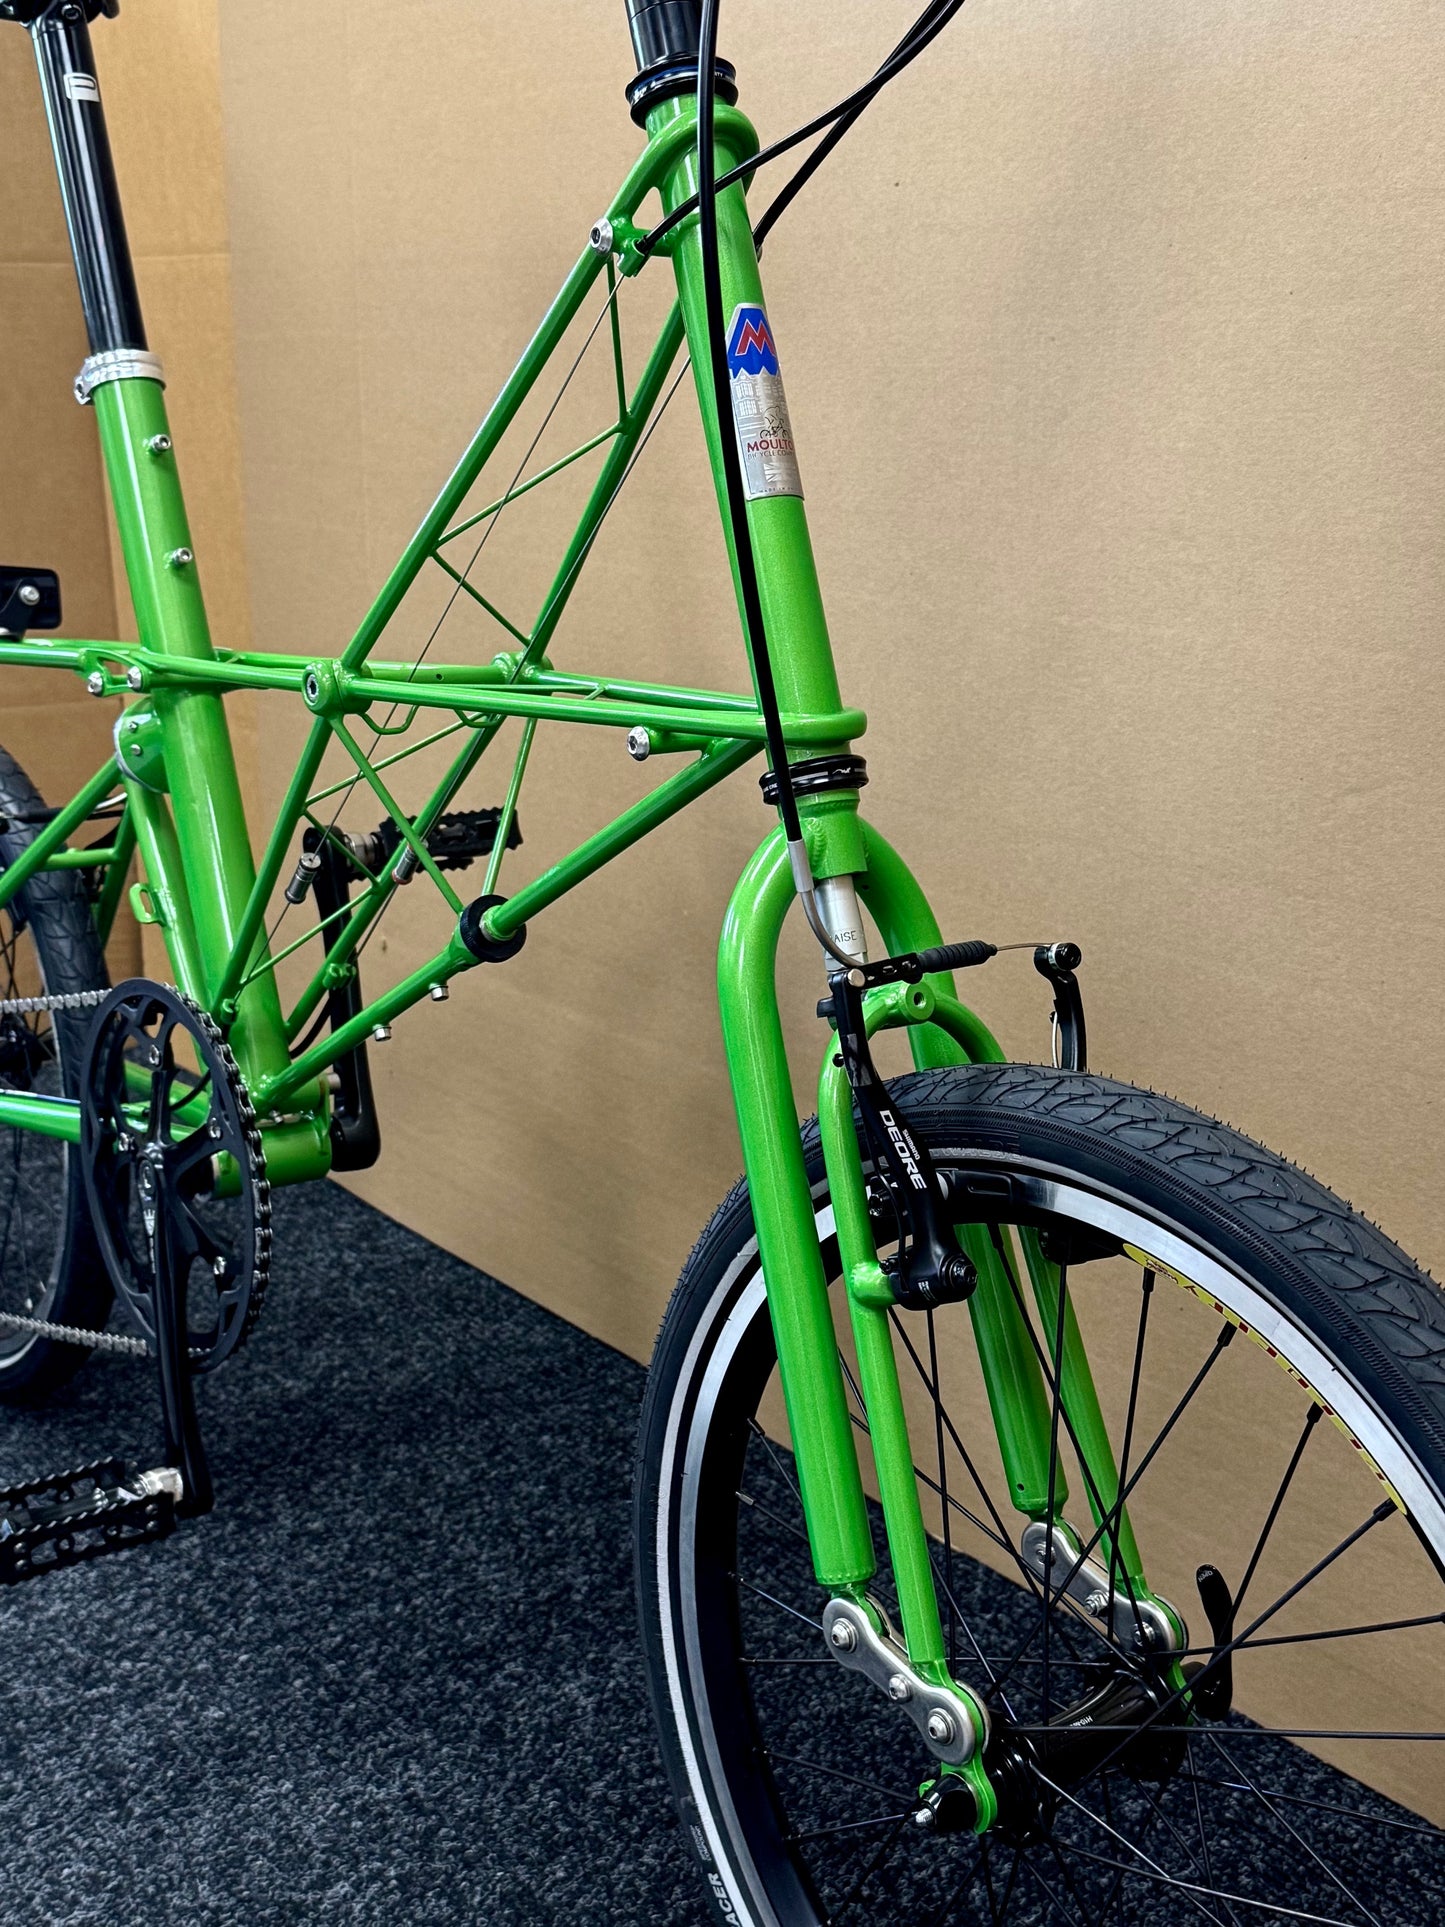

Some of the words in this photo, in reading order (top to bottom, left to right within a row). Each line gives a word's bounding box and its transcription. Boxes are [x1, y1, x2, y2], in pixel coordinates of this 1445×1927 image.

[834, 930, 858, 943] AISE
[879, 1109, 928, 1190] DEORE
[707, 1872, 742, 1927] ACER
